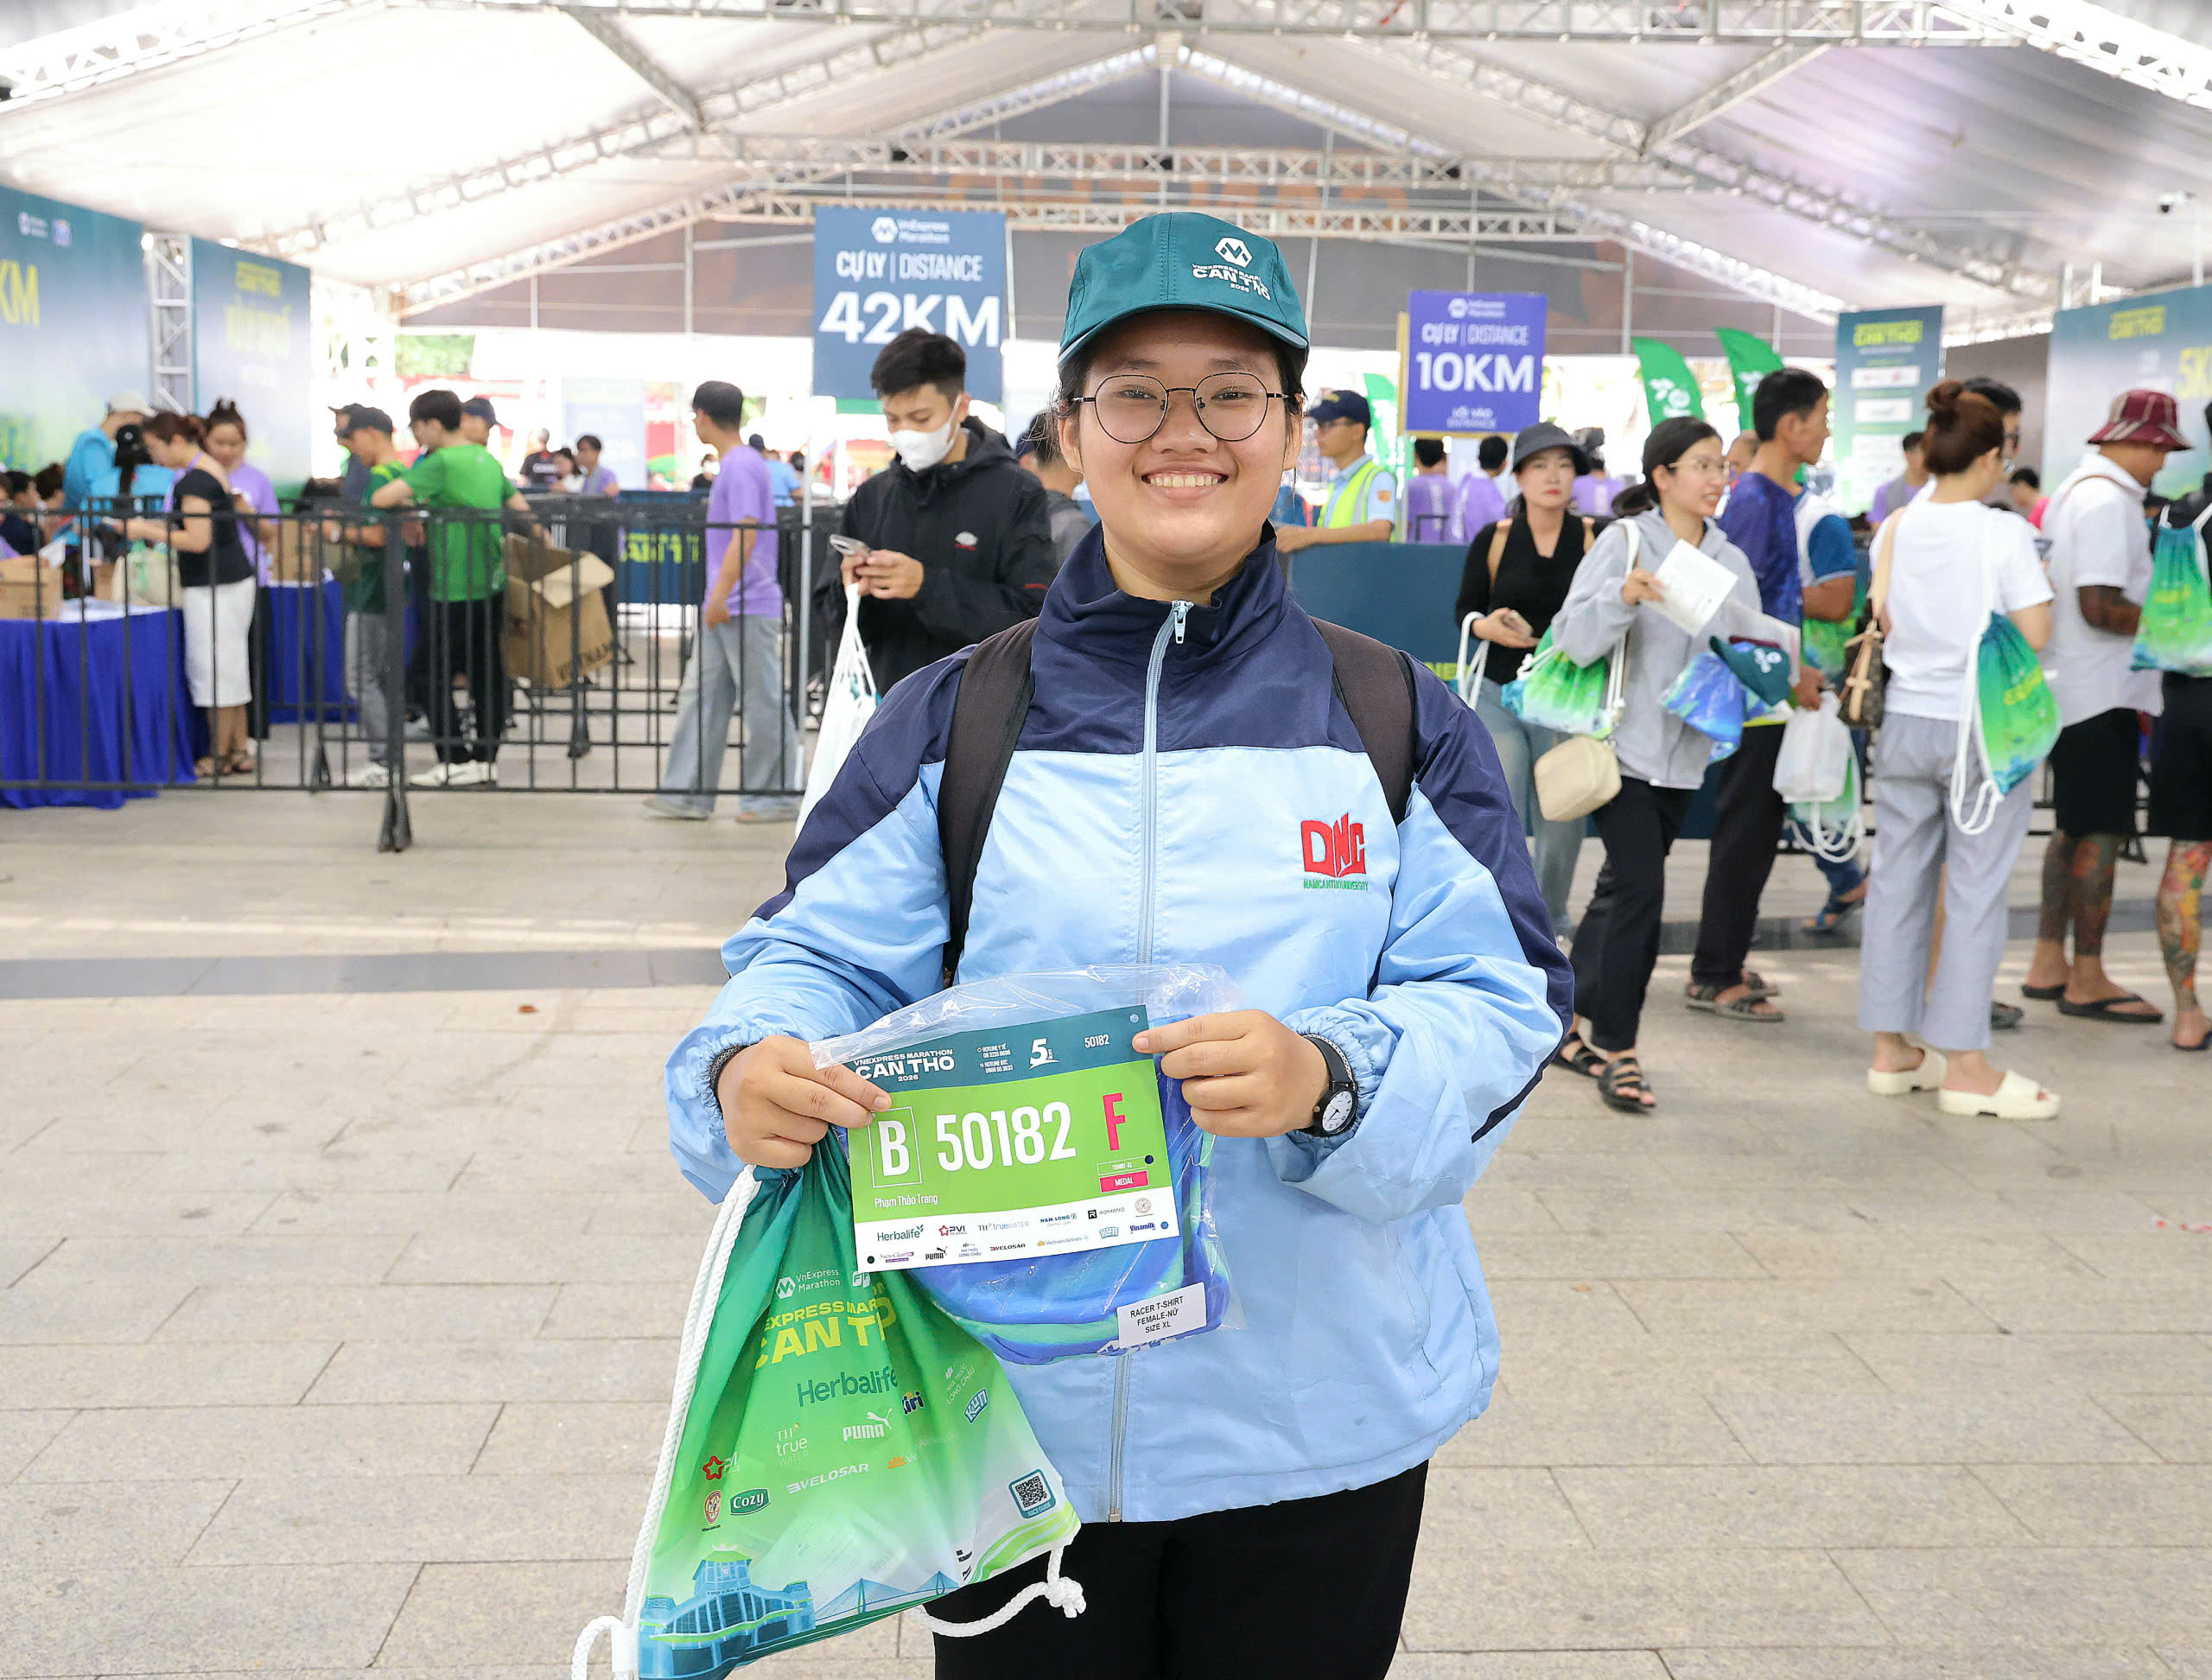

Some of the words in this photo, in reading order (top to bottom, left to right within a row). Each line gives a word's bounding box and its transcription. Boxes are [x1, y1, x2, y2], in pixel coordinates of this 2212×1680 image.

[899, 252, 983, 282] DISTANCE
[1192, 268, 1238, 283] CAN
[818, 291, 1001, 347] 42KM
[1415, 352, 1535, 393] 10KM
[1300, 811, 1367, 878] DNC
[1084, 1034, 1110, 1049] 50182
[854, 1053, 906, 1066] VNEXPRESS
[906, 1048, 954, 1060] MARATHON
[855, 1060, 906, 1081] CAN
[907, 1055, 955, 1074] THO
[1103, 1092, 1126, 1151] F
[936, 1101, 1077, 1172] 50182
[878, 1120, 911, 1177] B
[1115, 1176, 1134, 1187] MEDAL
[874, 1197, 897, 1209] Phạm
[898, 1194, 916, 1206] Thảo
[918, 1193, 938, 1206] Trang
[877, 1229, 921, 1242] Herbalife
[950, 1225, 966, 1233] PVI
[1099, 1206, 1126, 1215] ROMANO
[1129, 1222, 1156, 1232] Vinamilk
[925, 1252, 944, 1261] PUMA
[995, 1243, 1026, 1251] VELOSAR
[796, 1269, 840, 1282] VnExpress
[798, 1278, 841, 1294] Marathon
[1130, 1304, 1155, 1319] RACER
[1156, 1295, 1184, 1310] T-SHIRT
[1145, 1323, 1160, 1333] SIZE
[1162, 1320, 1172, 1329] XL
[797, 1365, 898, 1409] Herbalife
[842, 1423, 885, 1442] PUMA
[776, 1437, 808, 1457] true
[799, 1463, 869, 1491] VELOSAR
[733, 1492, 765, 1510] Cozy
